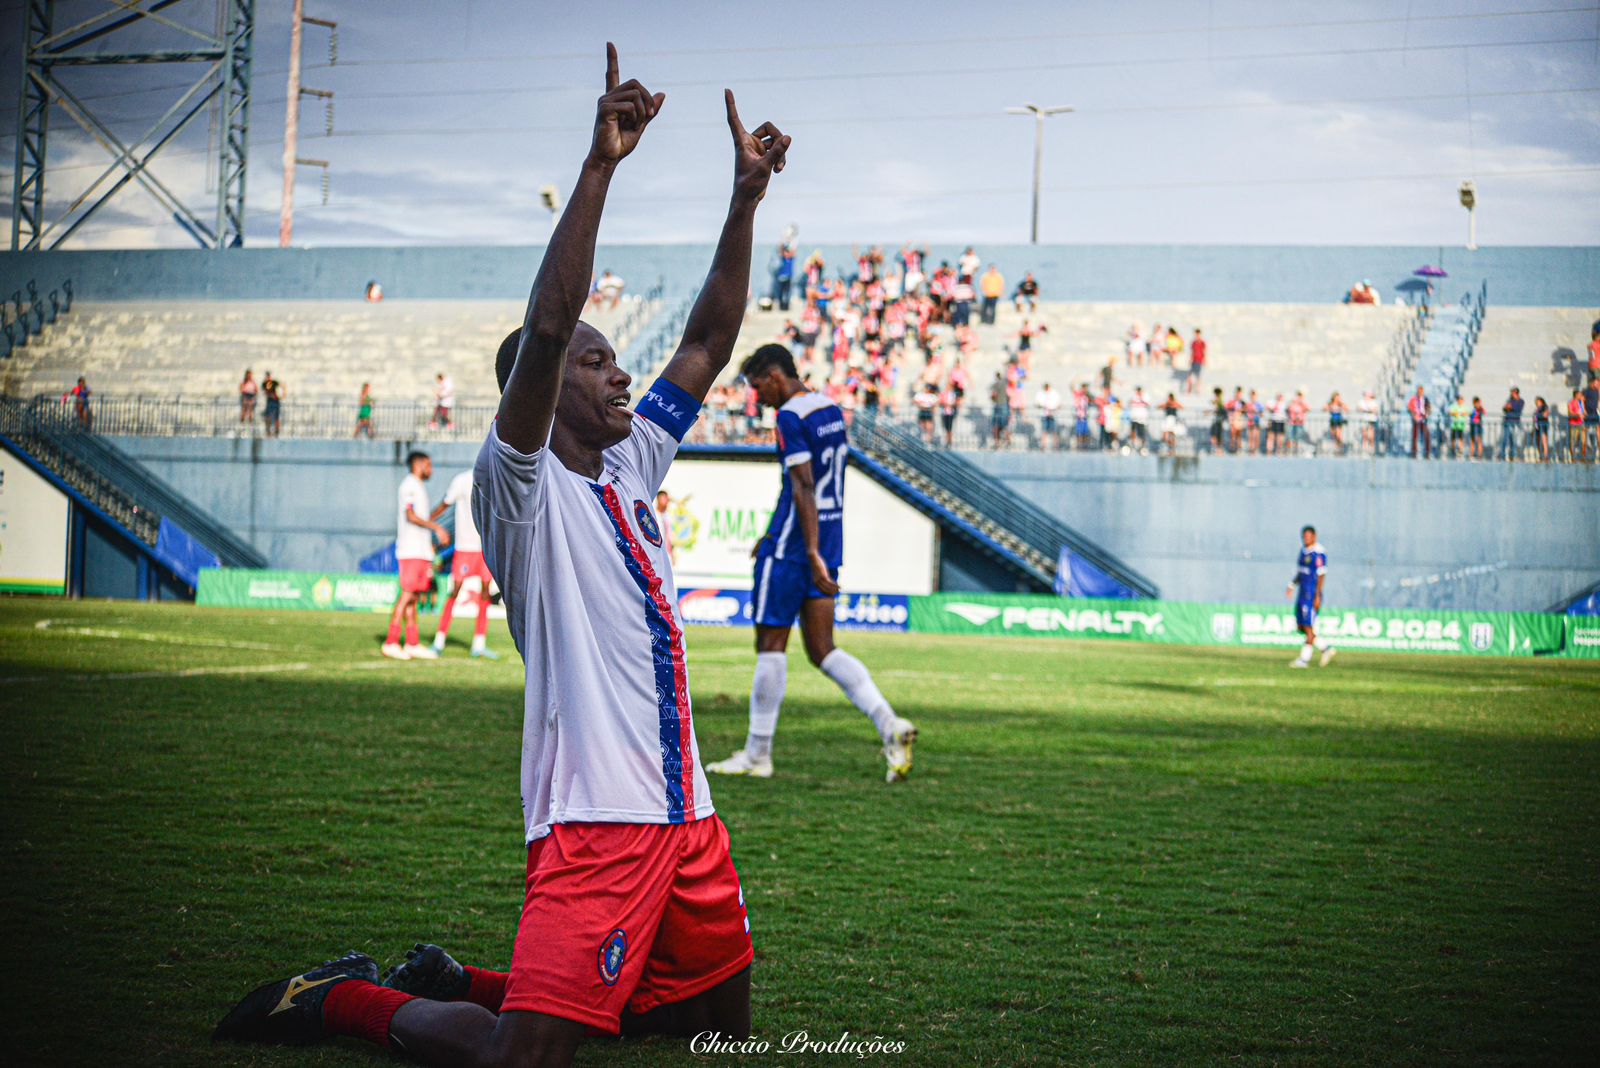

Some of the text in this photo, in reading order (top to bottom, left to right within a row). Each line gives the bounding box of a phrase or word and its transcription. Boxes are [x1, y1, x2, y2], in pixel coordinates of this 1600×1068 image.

[815, 443, 848, 510] 20
[1003, 606, 1163, 634] PENALTY
[1386, 618, 1461, 640] 2024
